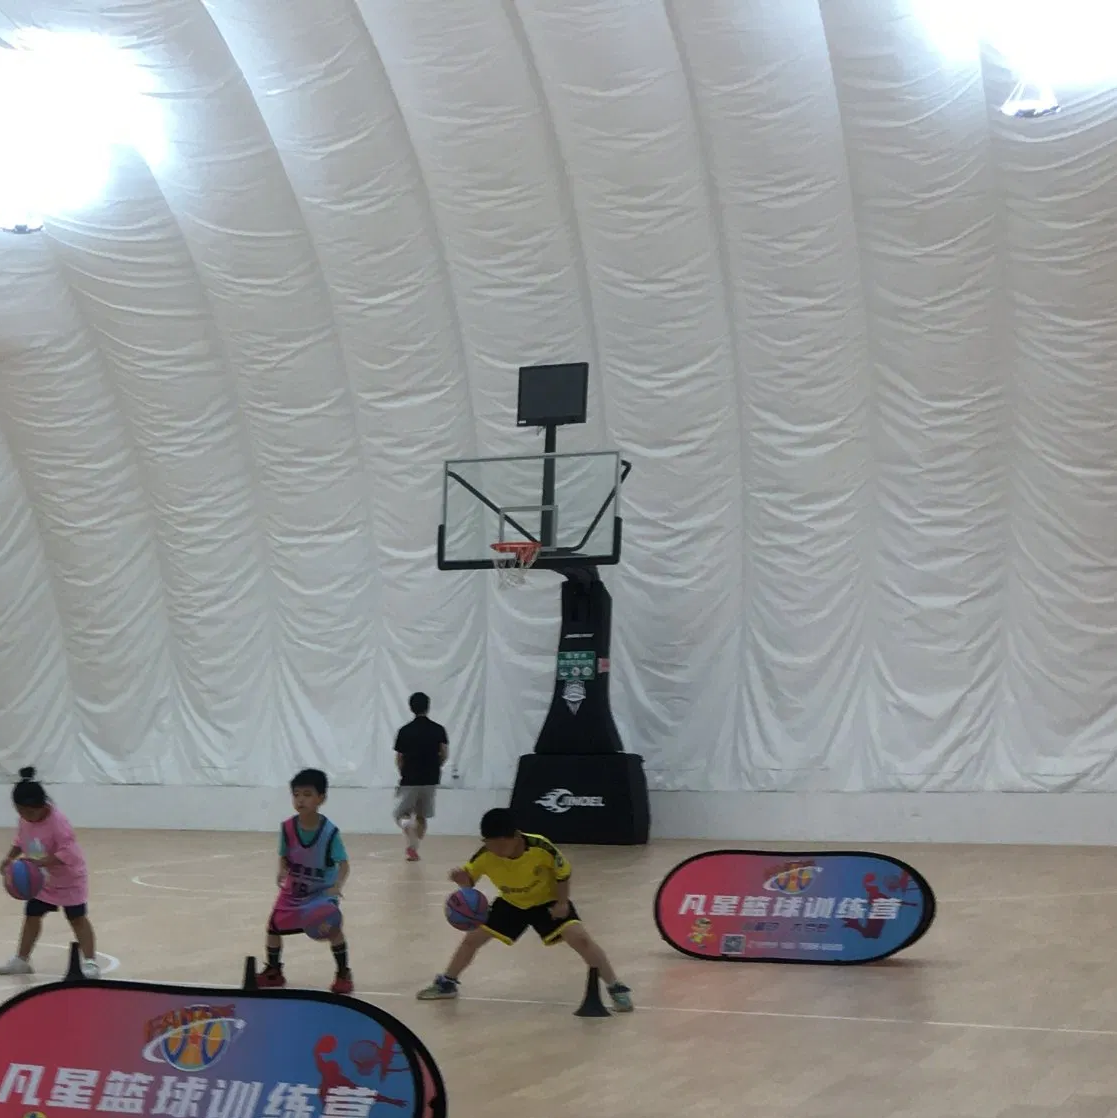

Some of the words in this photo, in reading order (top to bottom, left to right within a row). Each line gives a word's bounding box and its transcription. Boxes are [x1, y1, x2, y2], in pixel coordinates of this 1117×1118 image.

[678, 893, 904, 920] 凡星篮球训练营
